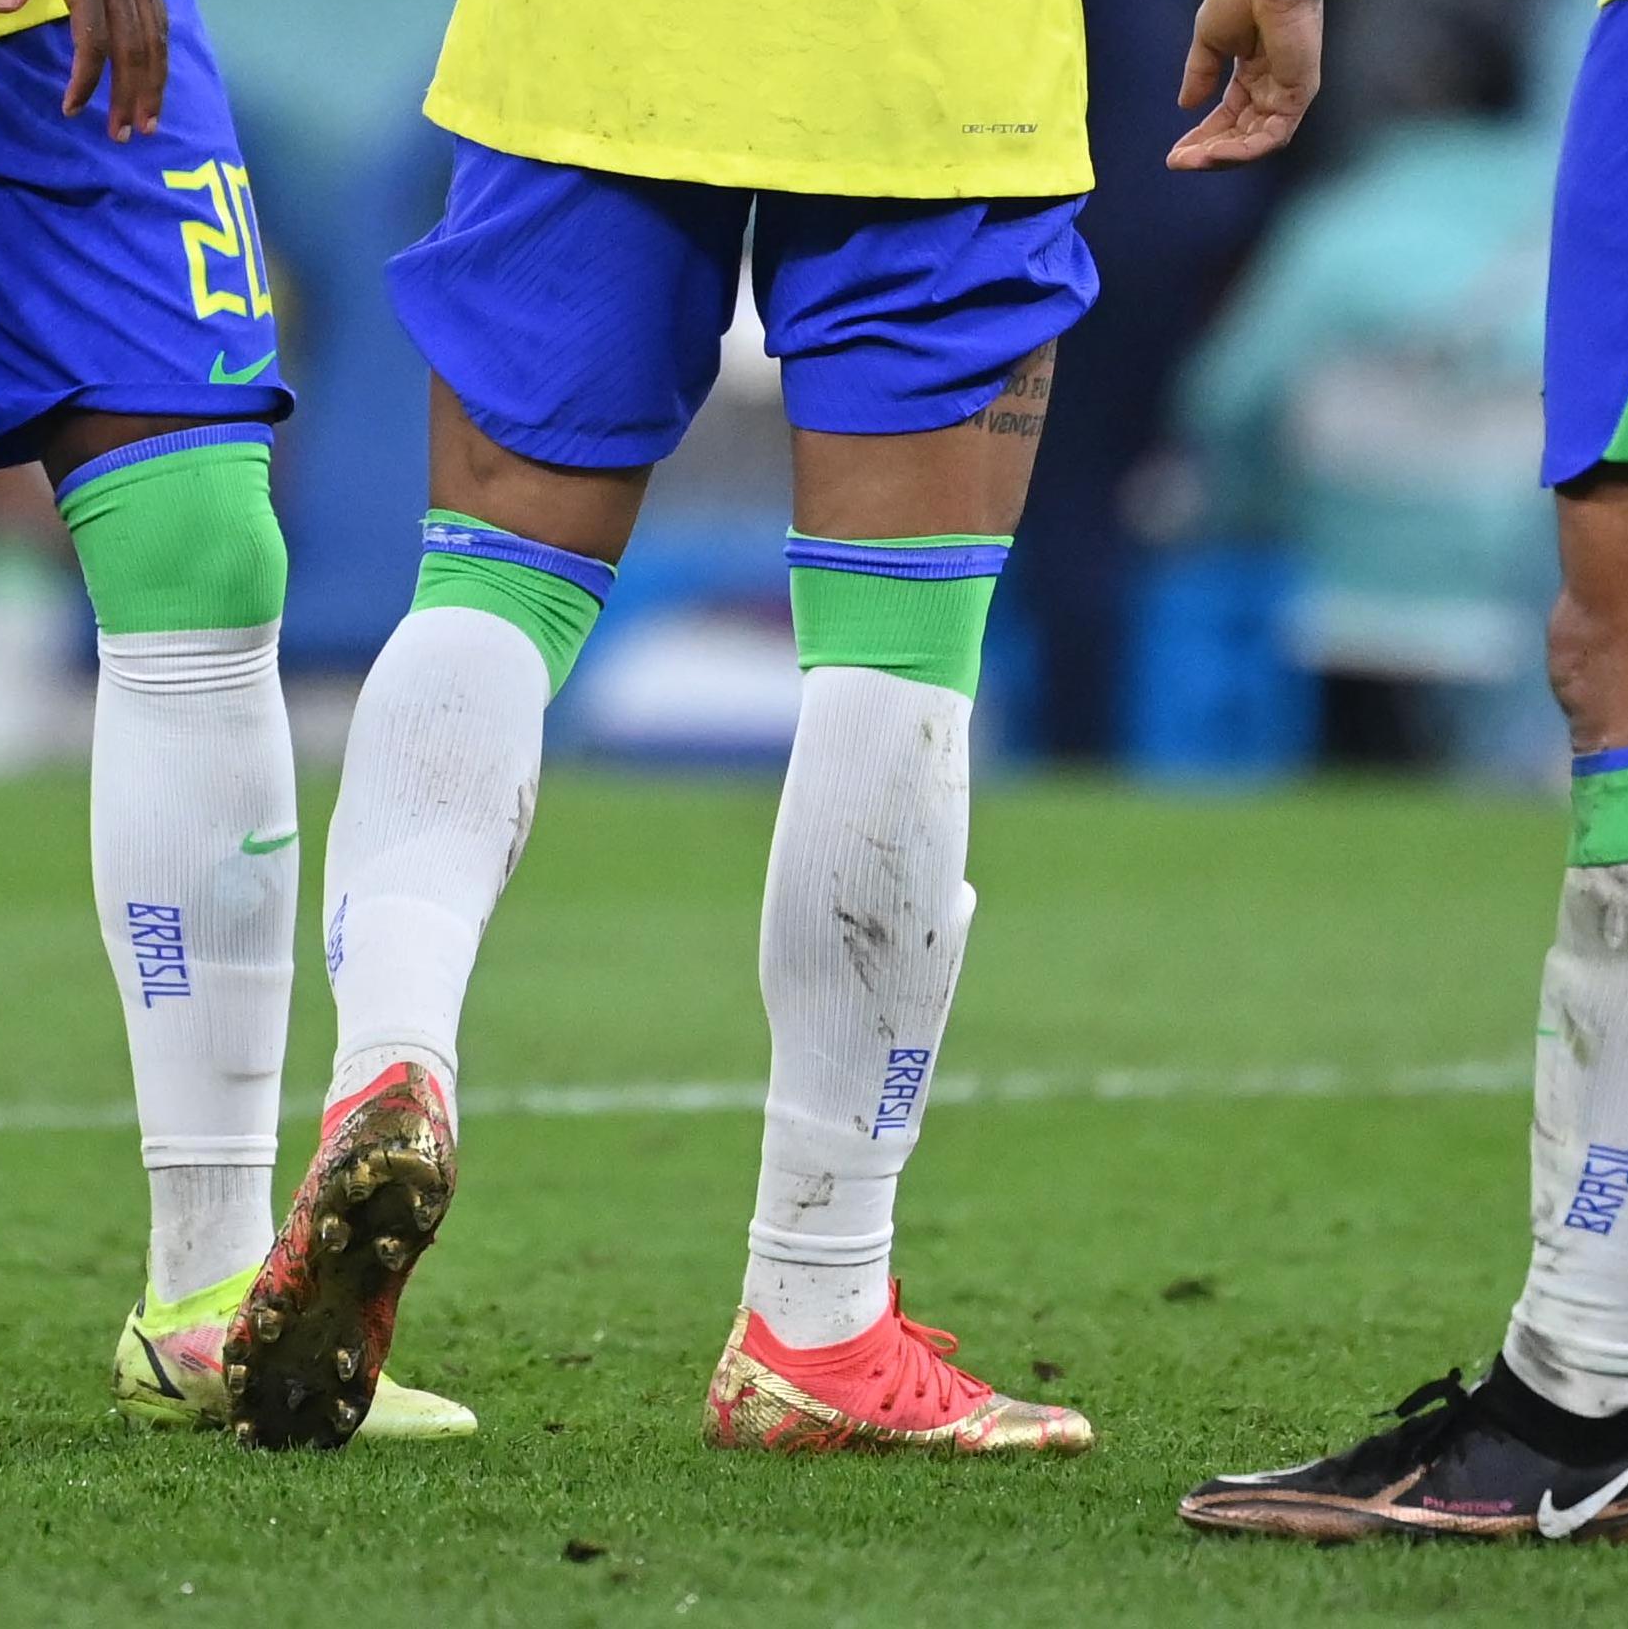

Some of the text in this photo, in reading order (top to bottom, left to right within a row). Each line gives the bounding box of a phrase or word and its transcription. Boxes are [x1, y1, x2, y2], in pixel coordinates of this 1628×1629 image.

[161, 158, 274, 321] 20
[127, 902, 191, 1009] BRASIL
[872, 1049, 930, 1140] BRASIL
